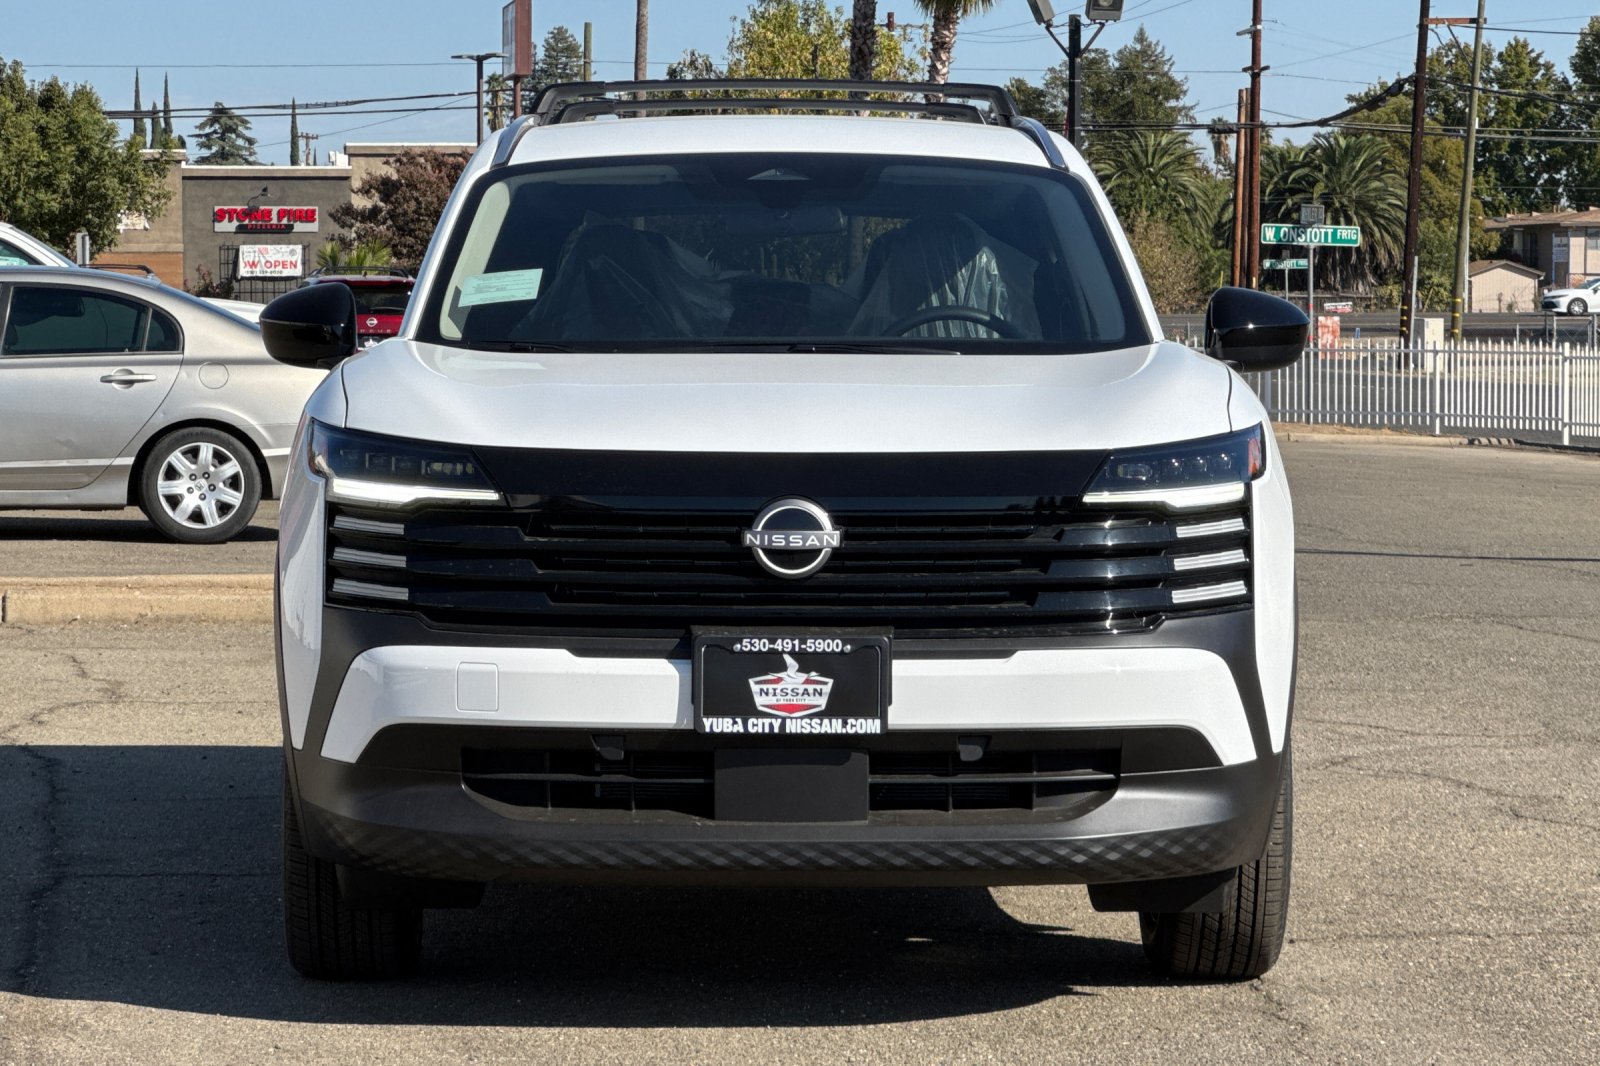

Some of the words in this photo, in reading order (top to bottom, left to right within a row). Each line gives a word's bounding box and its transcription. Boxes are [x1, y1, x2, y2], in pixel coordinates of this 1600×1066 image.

[215, 207, 273, 223] STONE
[277, 208, 317, 223] FIRE
[1280, 227, 1334, 243] ONSTOTT
[1337, 229, 1357, 240] FRTG
[264, 260, 298, 270] OPEN
[746, 533, 837, 547] NISSAN
[742, 639, 843, 652] 530-491-5900
[759, 687, 823, 697] NISSAN
[702, 717, 744, 734] YUBA
[747, 717, 782, 734] CITY
[786, 717, 881, 734] NISSAN.COM
